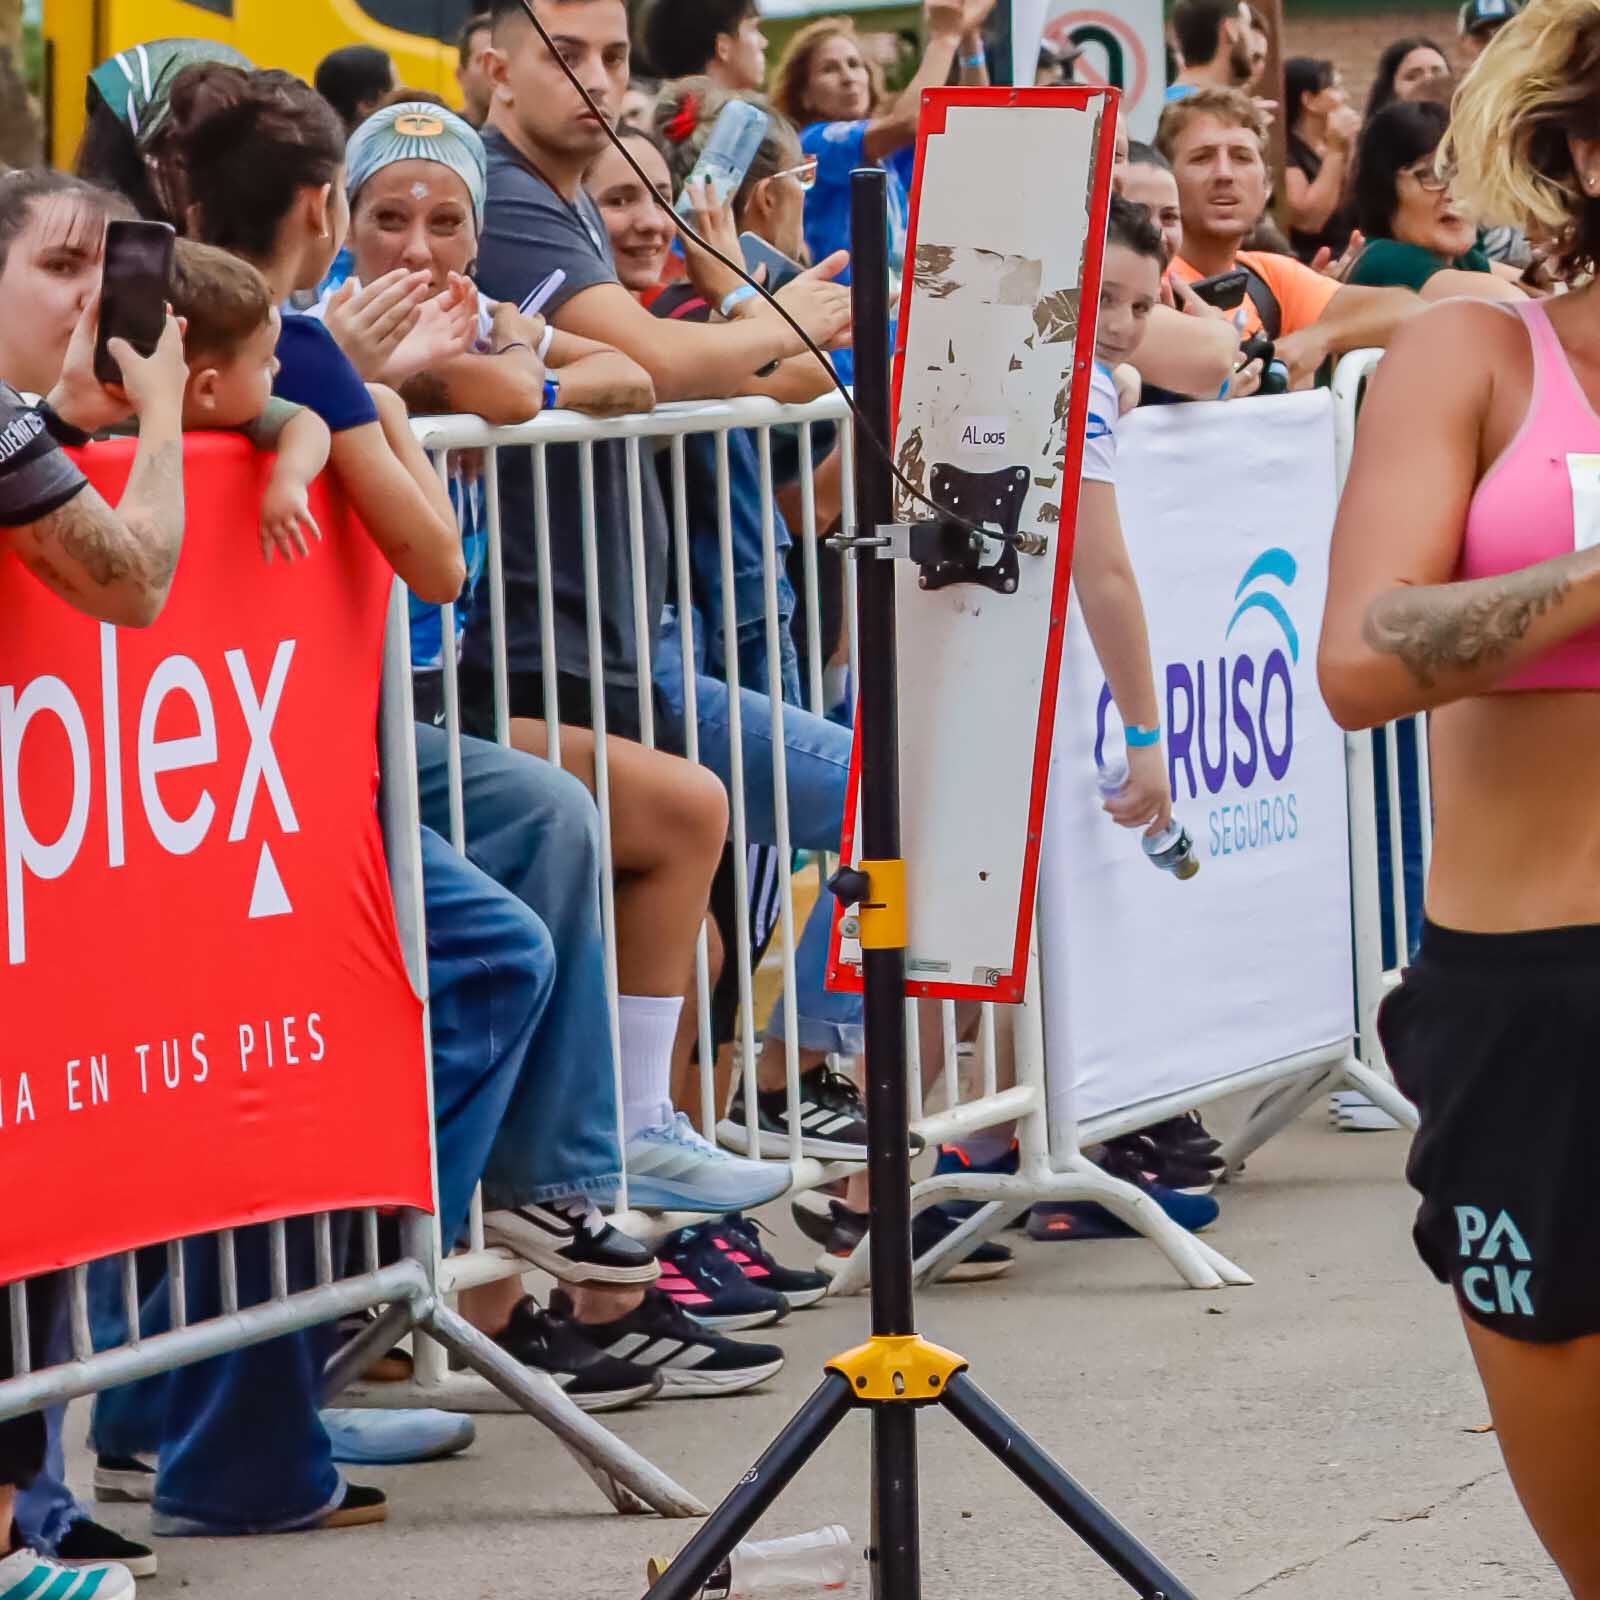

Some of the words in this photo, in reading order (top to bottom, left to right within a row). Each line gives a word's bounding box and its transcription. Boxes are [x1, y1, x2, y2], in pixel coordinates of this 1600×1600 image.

[0, 621, 300, 966] plex
[1208, 793, 1299, 858] SEGUROS
[66, 1053, 109, 1112] EN
[134, 1031, 209, 1094] TUS
[238, 1011, 326, 1073] PIES
[1453, 1205, 1533, 1261] PA
[1461, 1264, 1535, 1316] CK
